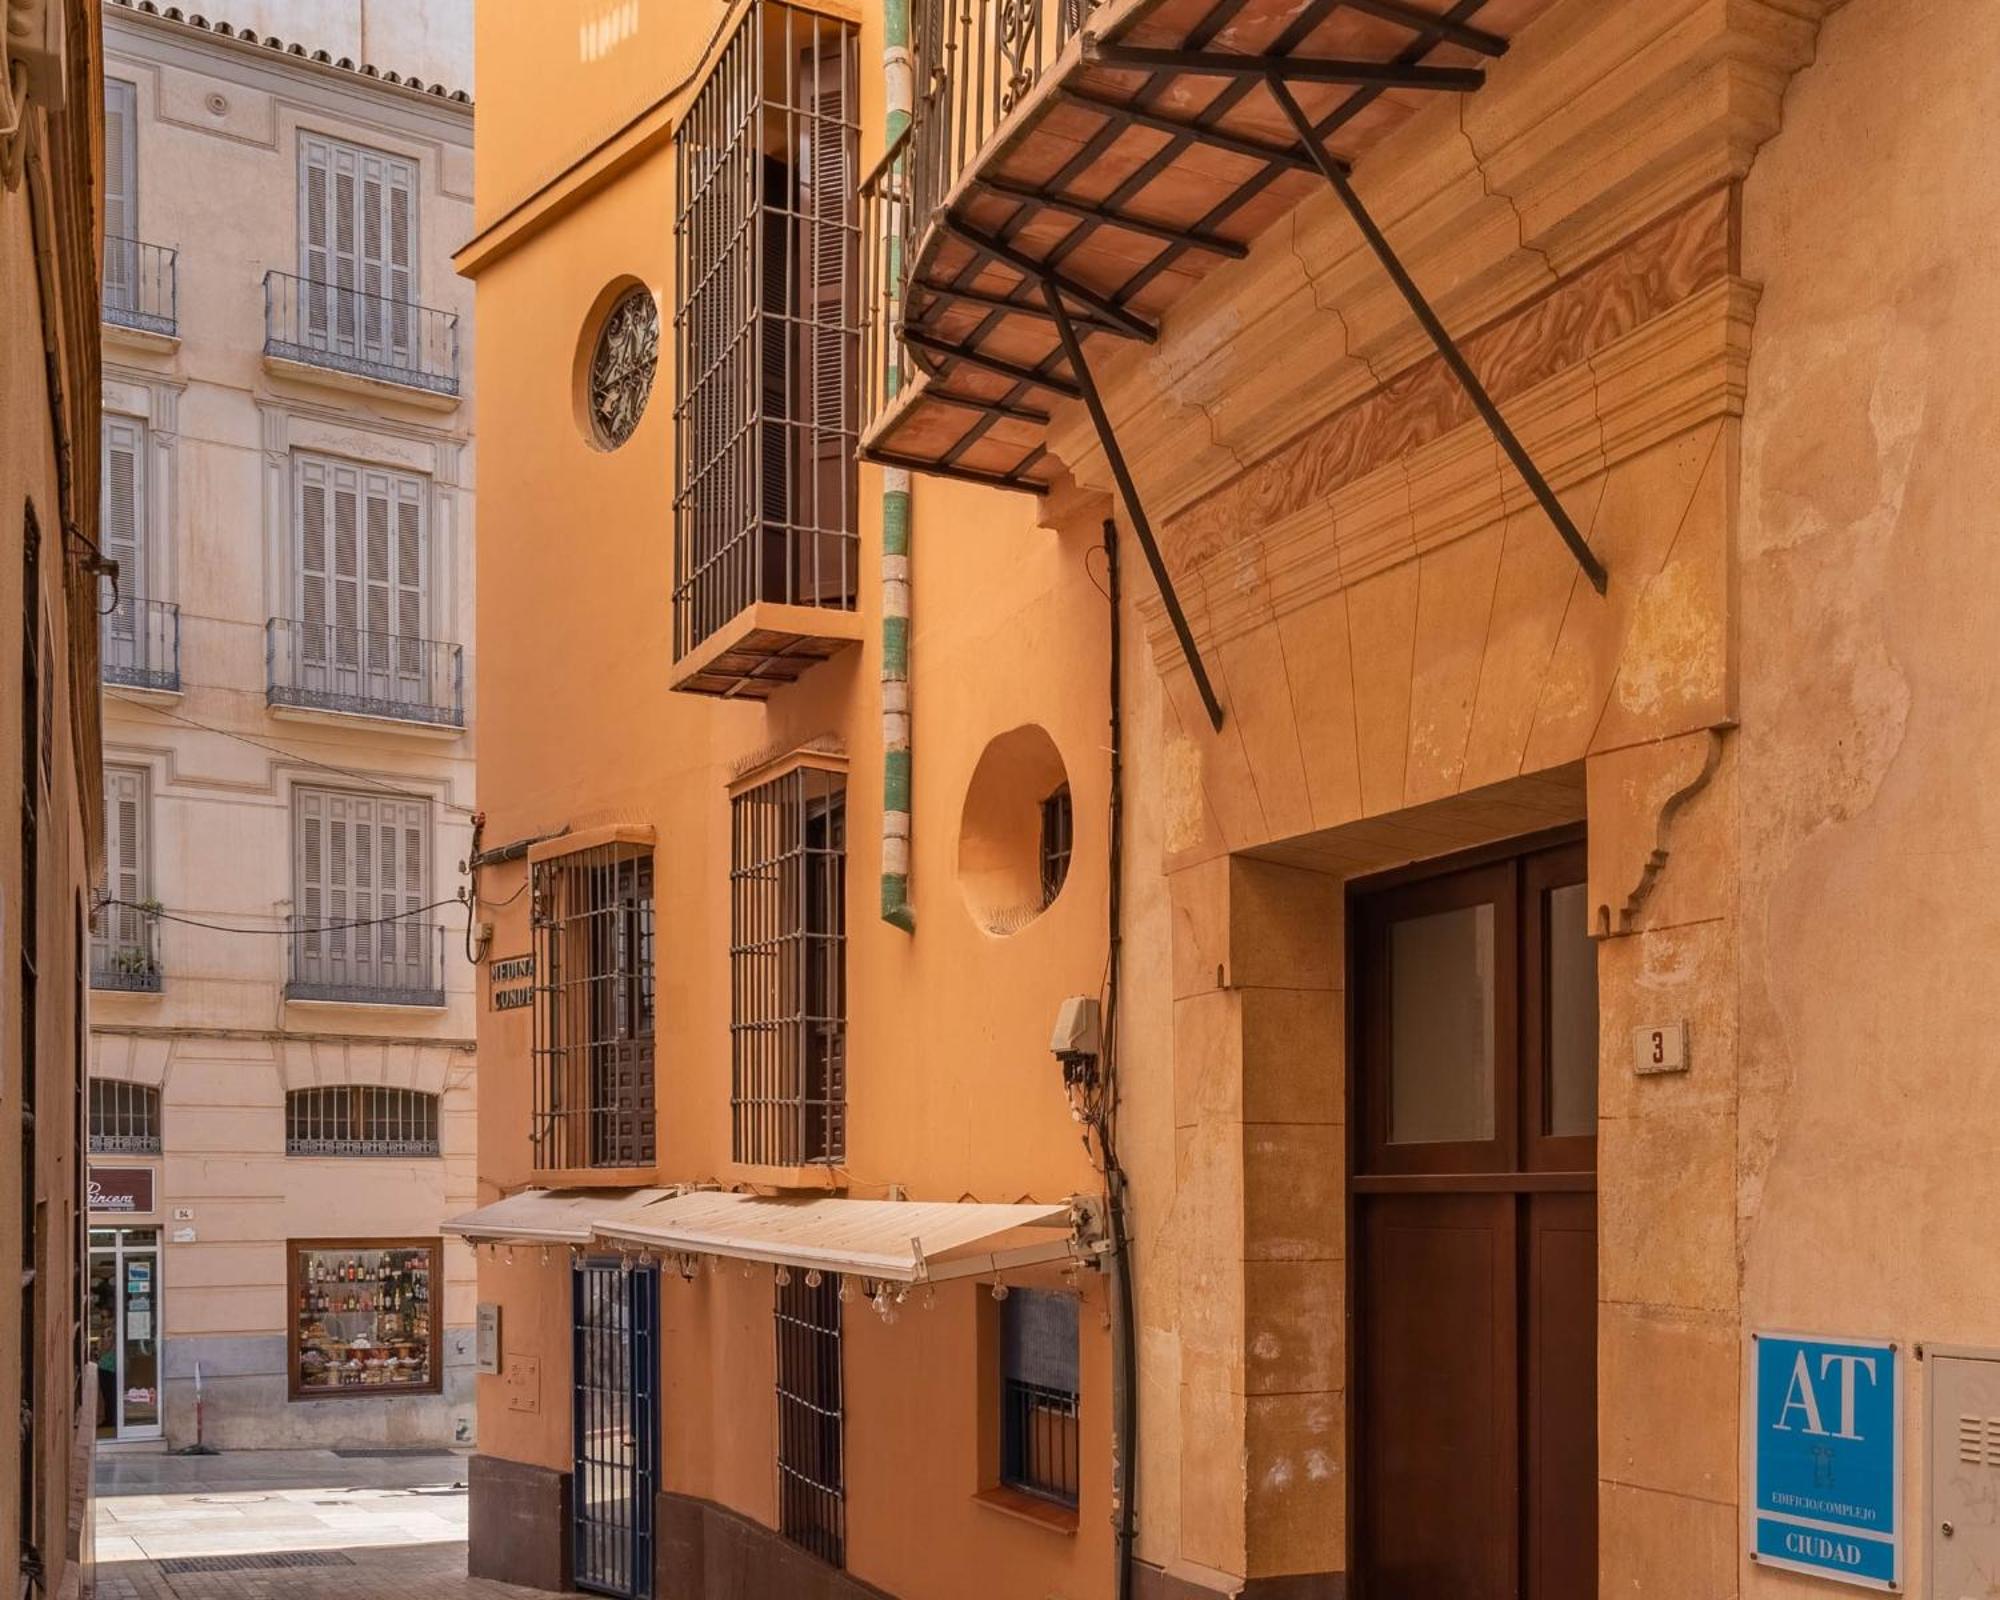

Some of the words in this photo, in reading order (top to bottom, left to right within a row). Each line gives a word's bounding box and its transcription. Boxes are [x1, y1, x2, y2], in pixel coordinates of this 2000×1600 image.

[491, 958, 536, 982] MEDINA
[1652, 1031, 1664, 1064] 3
[1772, 1349, 1877, 1441] AT
[1772, 1491, 1876, 1521] EDIFICIO/COMPLEJO
[1785, 1532, 1861, 1565] CIUDAD
